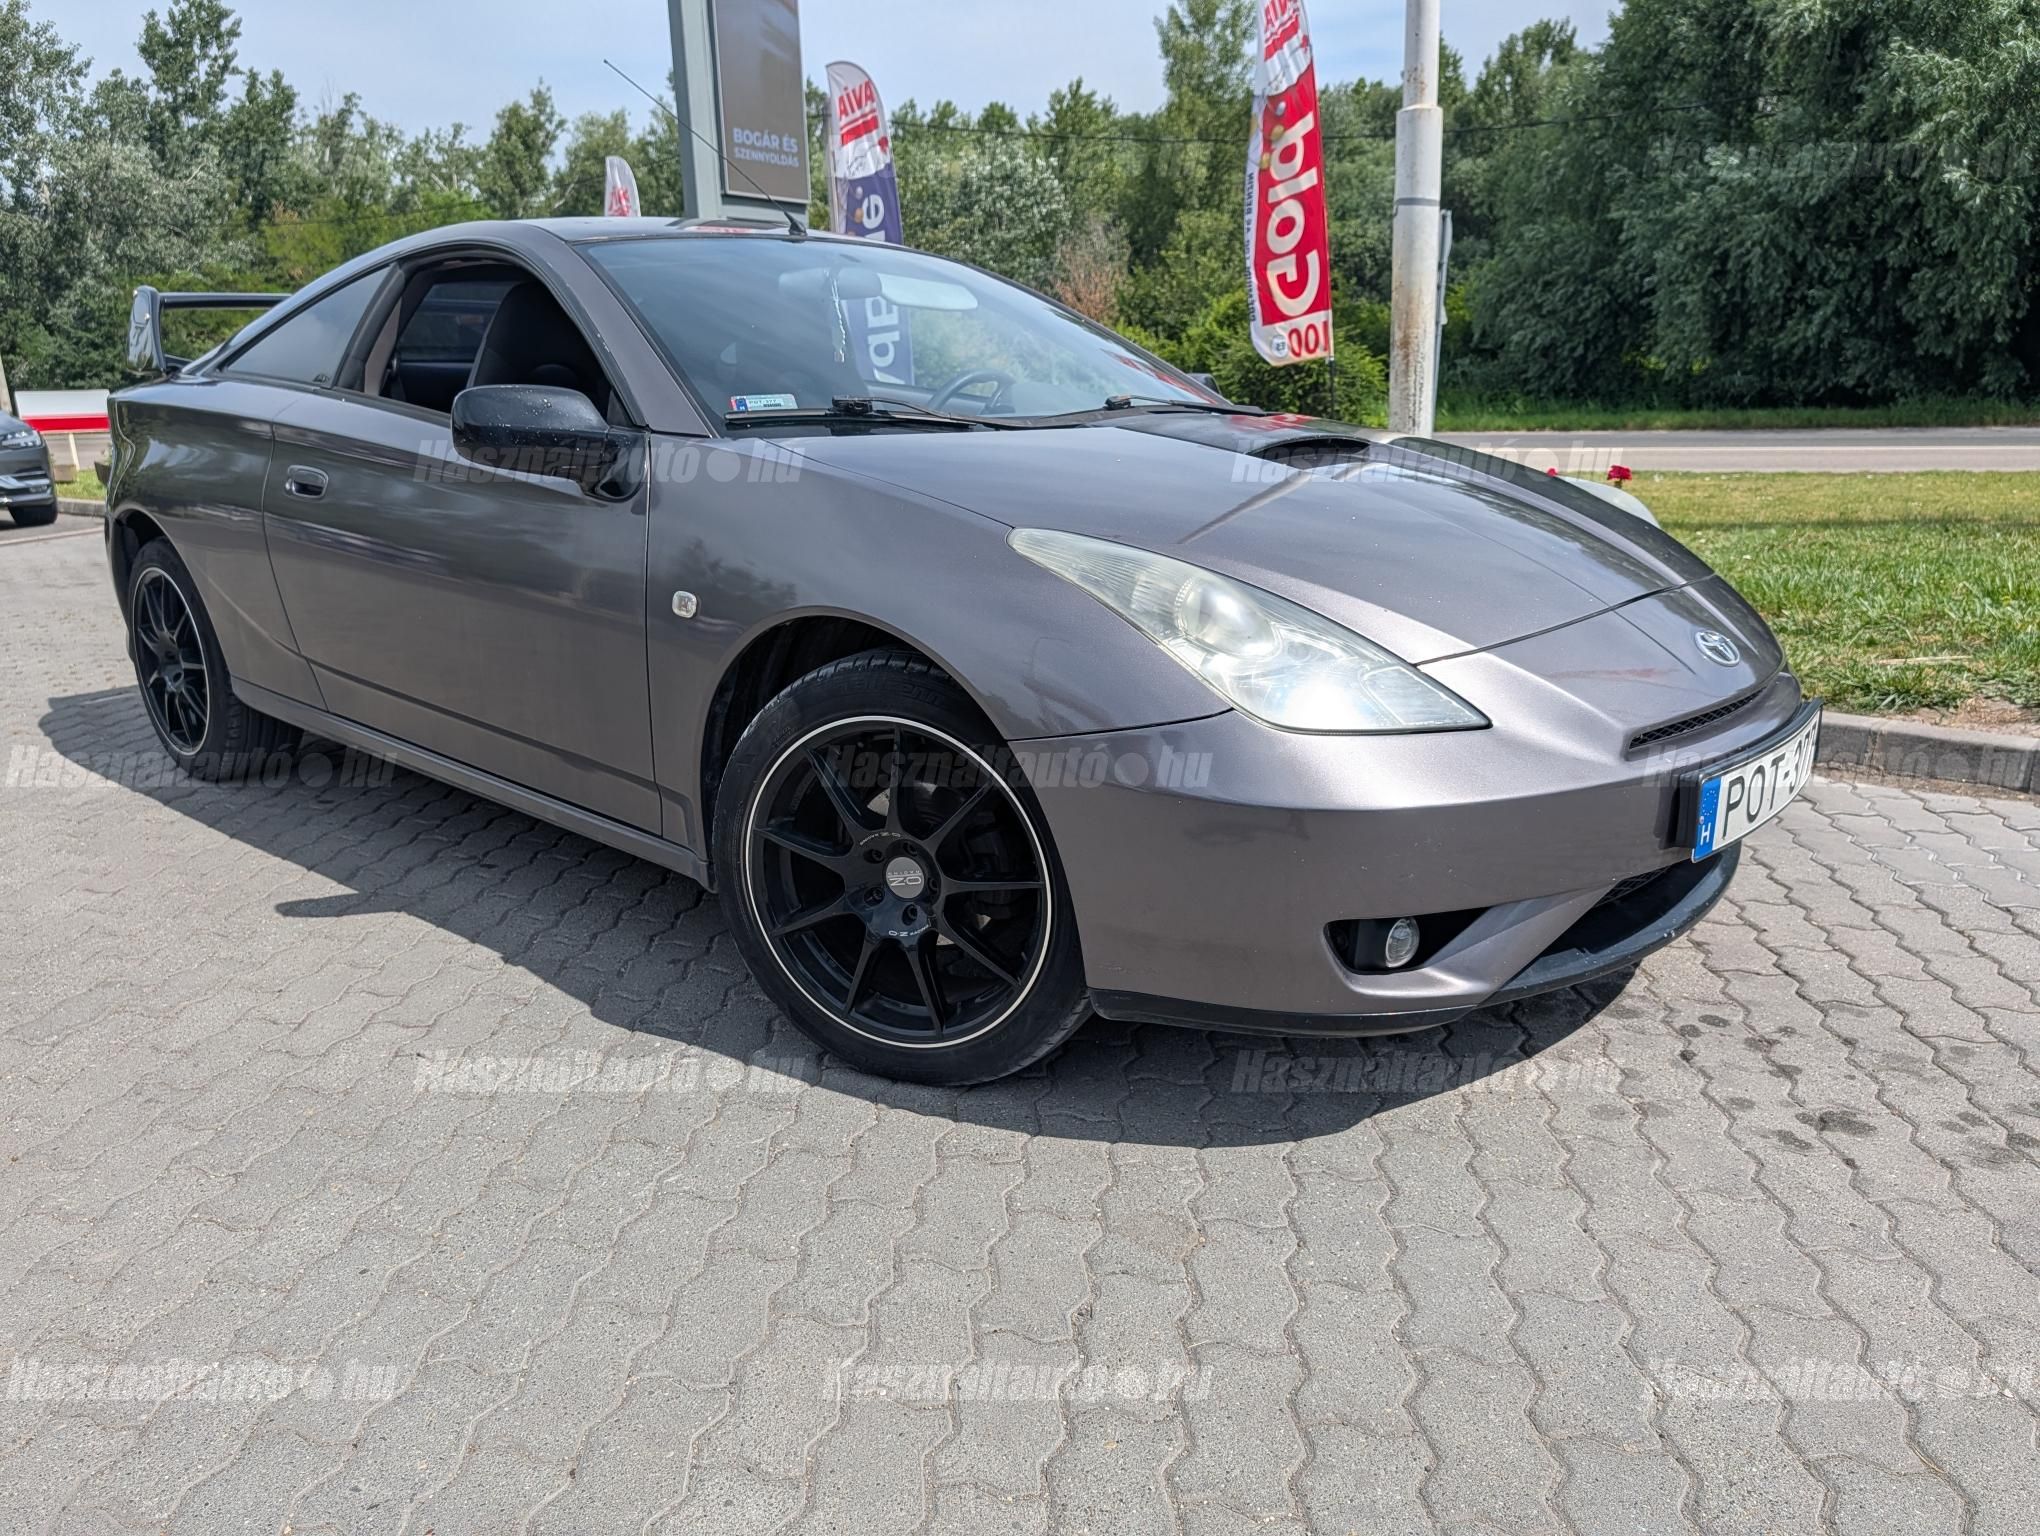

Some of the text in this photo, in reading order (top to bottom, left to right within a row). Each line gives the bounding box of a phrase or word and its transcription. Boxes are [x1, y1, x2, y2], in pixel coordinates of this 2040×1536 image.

[732, 128, 799, 153] BOGÁR ÉS
[734, 147, 800, 168] SZENNYOLDÁS
[1700, 822, 1712, 846] H
